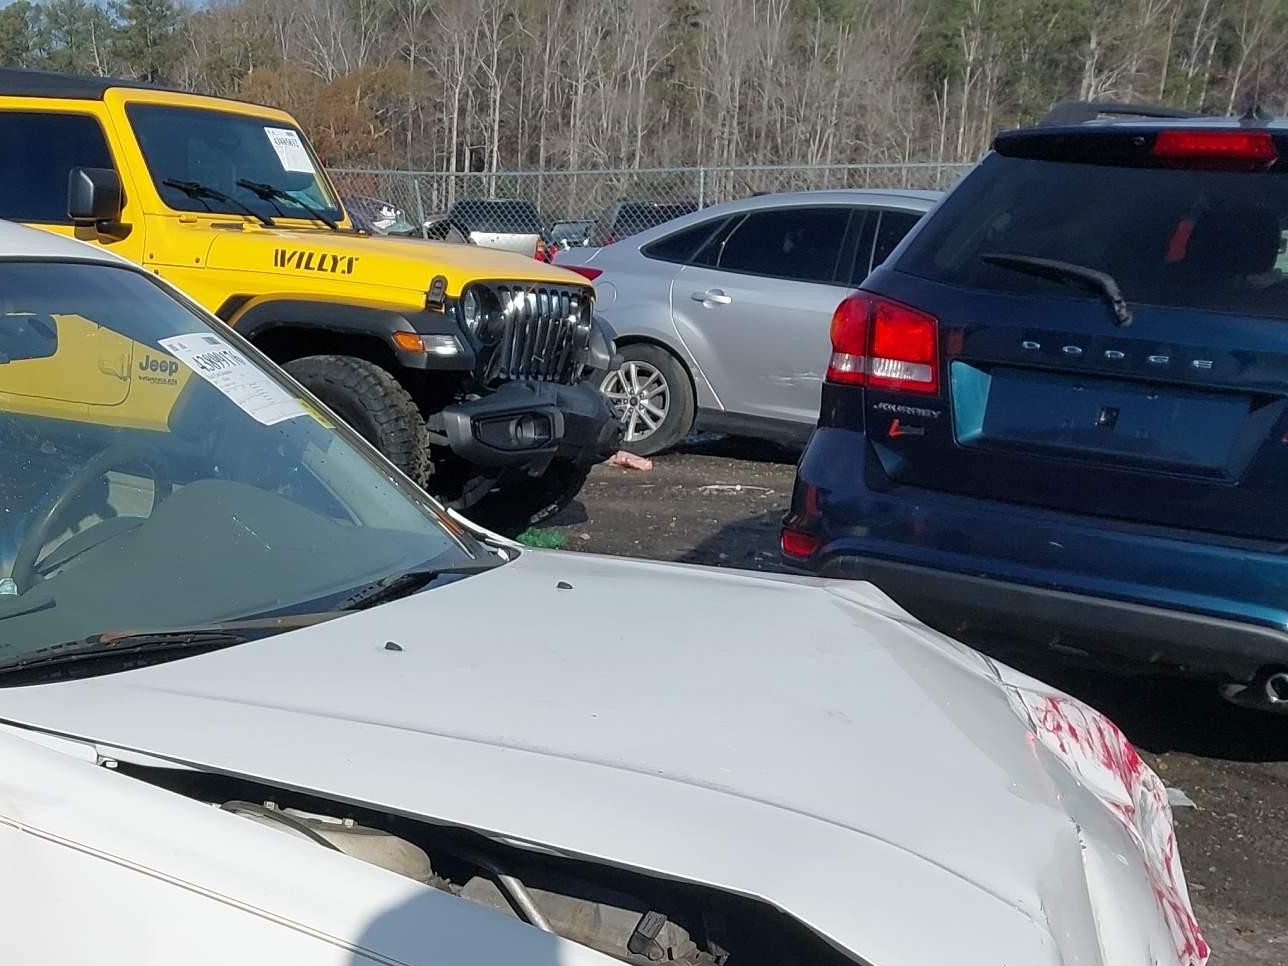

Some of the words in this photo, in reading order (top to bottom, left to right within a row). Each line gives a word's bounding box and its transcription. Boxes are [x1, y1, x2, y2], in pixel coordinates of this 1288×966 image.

[273, 248, 360, 275] WILLYS
[139, 354, 179, 376] Jeep
[1022, 340, 1214, 369] DODGE
